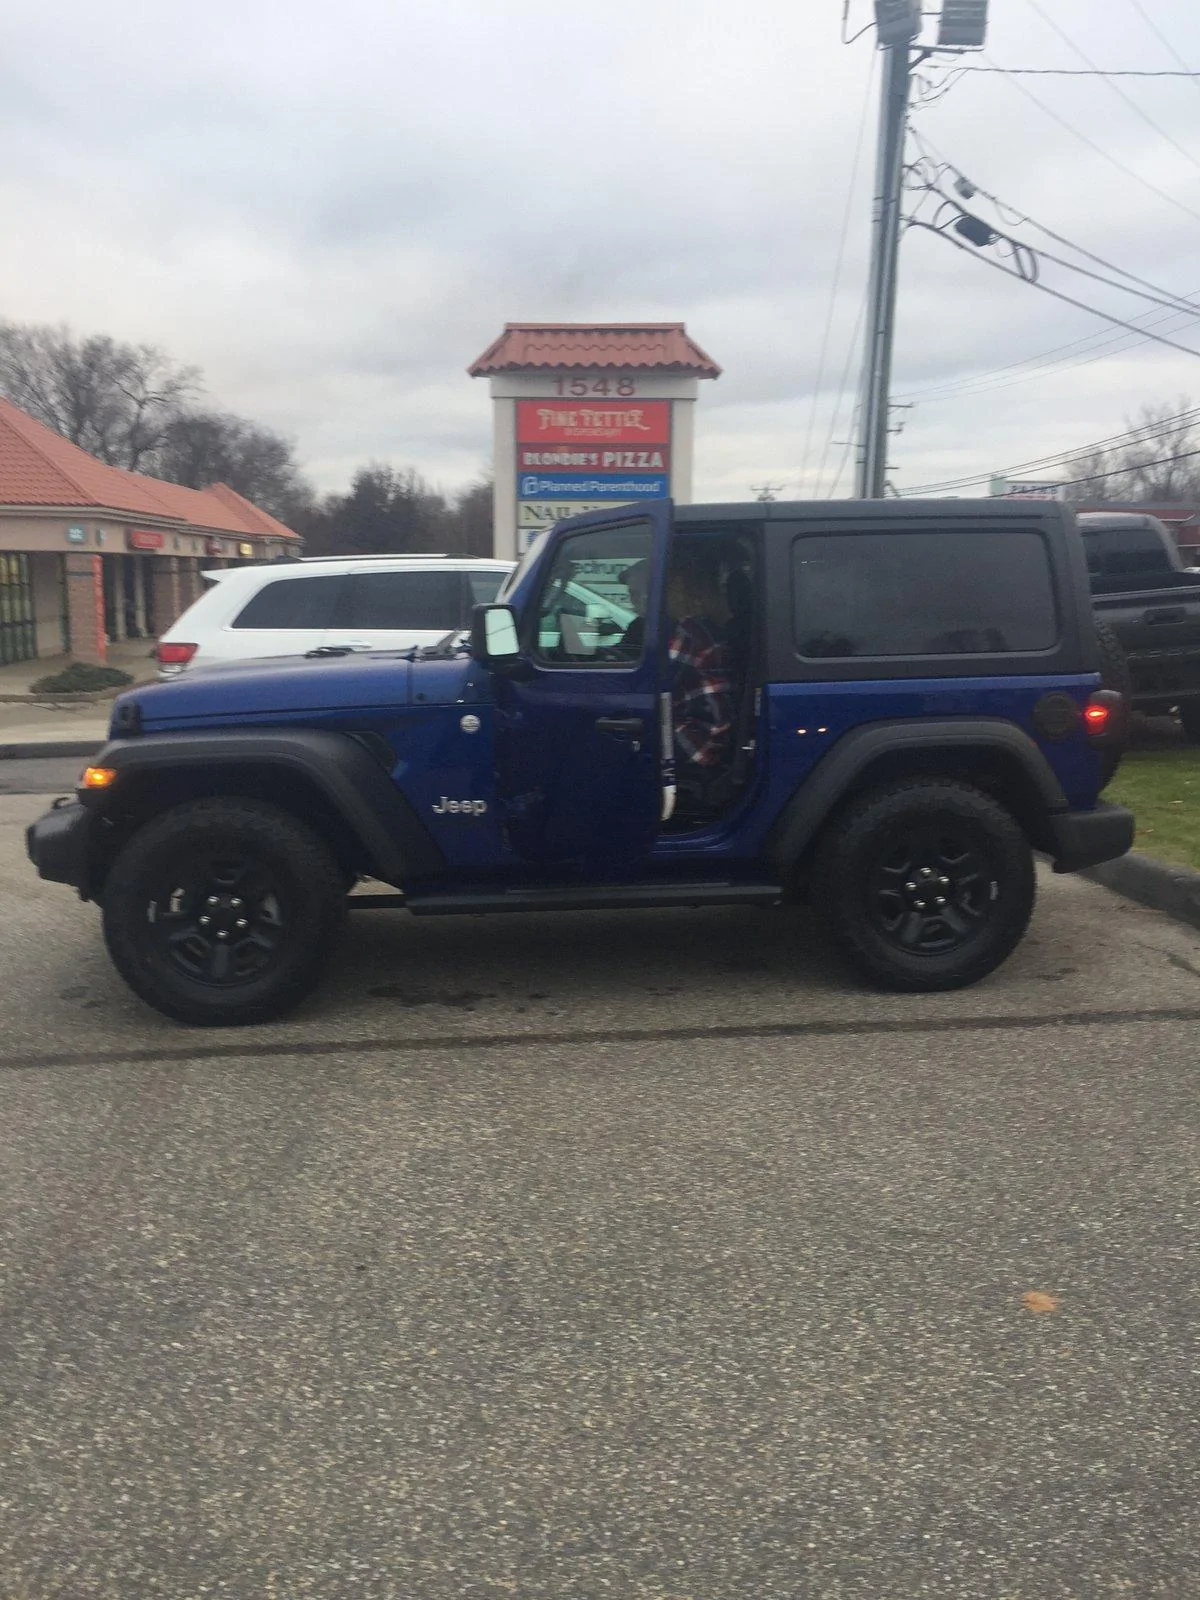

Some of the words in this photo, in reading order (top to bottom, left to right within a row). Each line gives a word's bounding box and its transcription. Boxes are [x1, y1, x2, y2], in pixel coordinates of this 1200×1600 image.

[551, 377, 635, 397] 1548
[536, 409, 577, 429] FINE
[601, 452, 664, 467] PIZZA
[539, 480, 588, 492] Planned
[432, 796, 489, 816] Jeep
